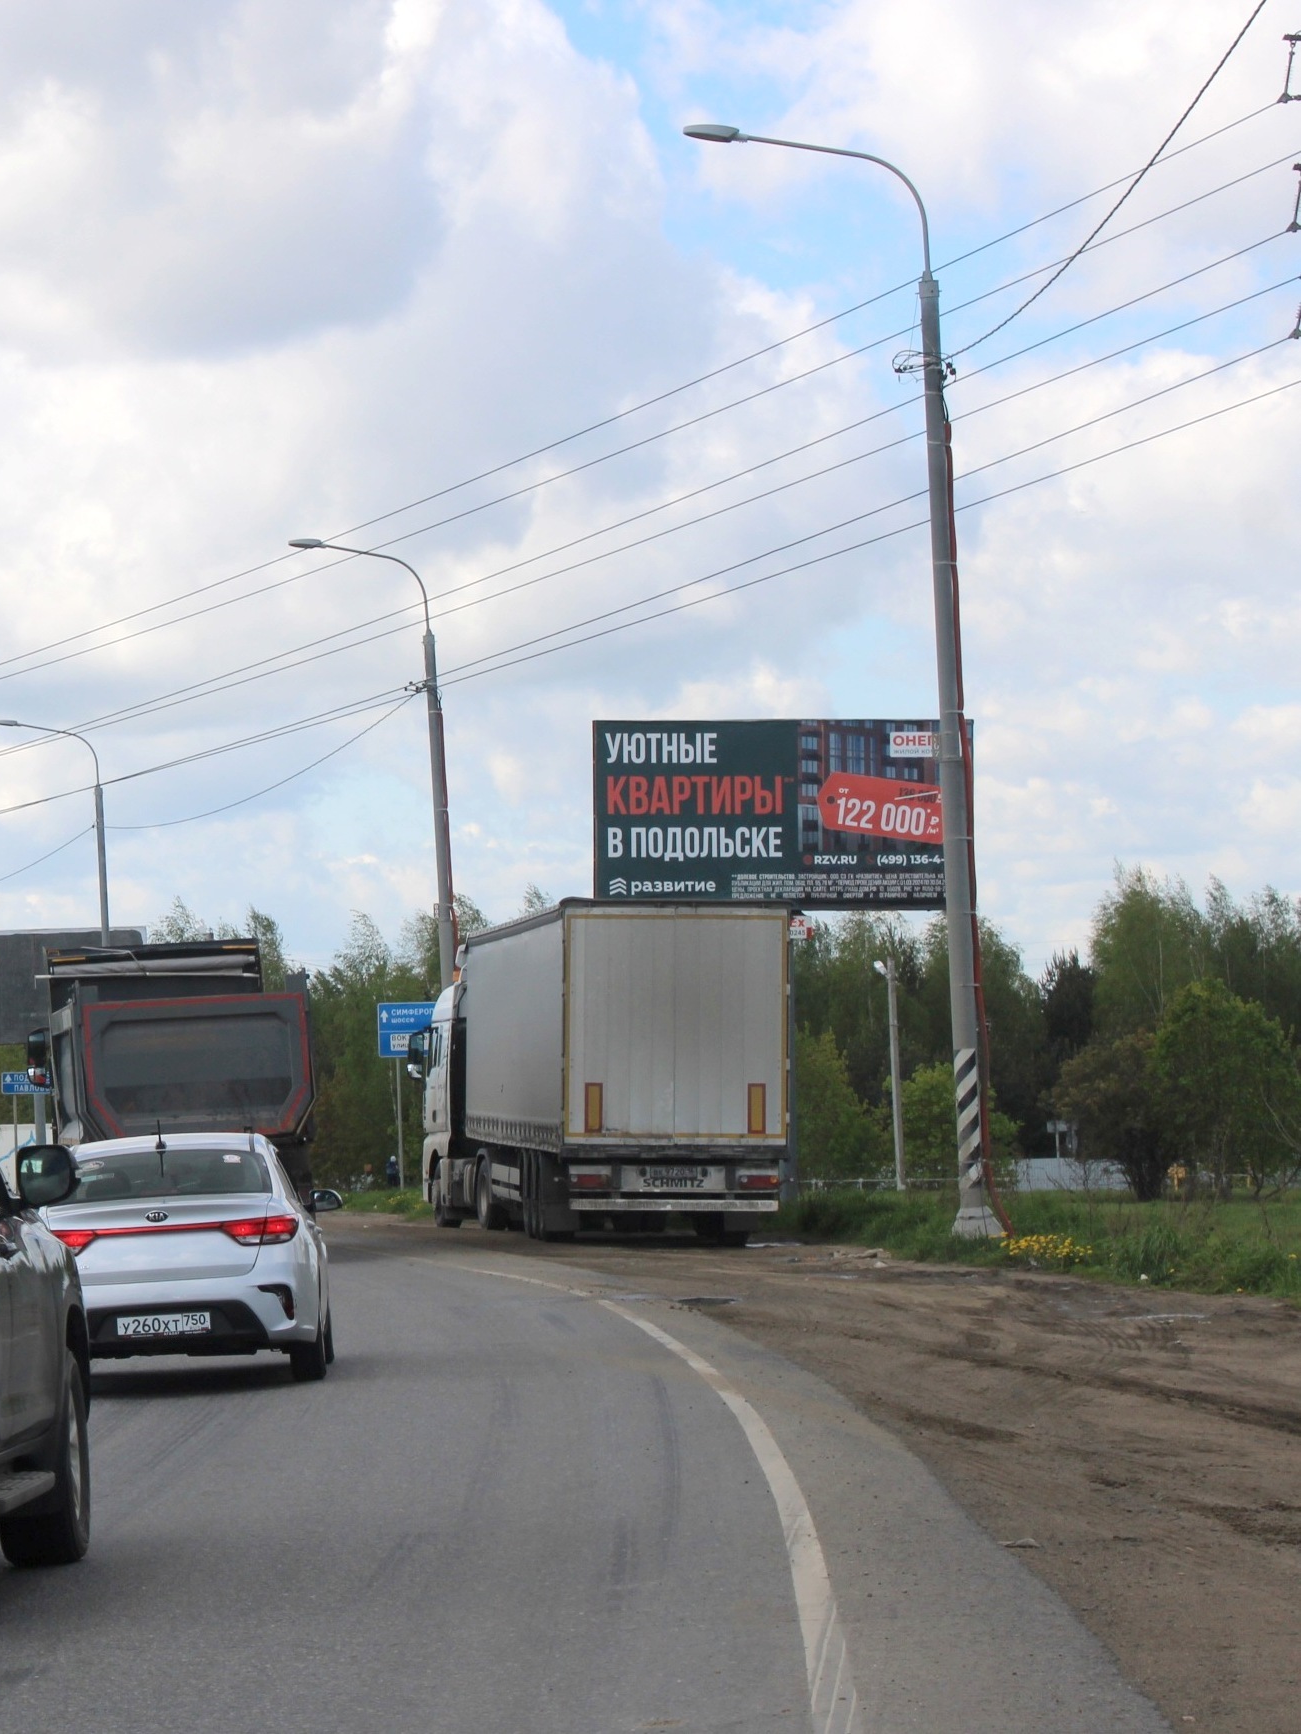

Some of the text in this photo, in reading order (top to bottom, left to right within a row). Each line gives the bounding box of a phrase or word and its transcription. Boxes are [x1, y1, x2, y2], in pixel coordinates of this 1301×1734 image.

[605, 732, 718, 764] УЮТНЫЕ
[837, 797, 876, 829] 122
[607, 826, 783, 862] В ПОДОЛЬСКЕ
[814, 855, 857, 865] RZV.RU
[877, 854, 907, 866] (499)
[631, 880, 716, 895] развитие
[643, 1178, 704, 1188] SCHMITZ
[148, 1213, 165, 1221] KIA
[183, 1313, 207, 1326] 750
